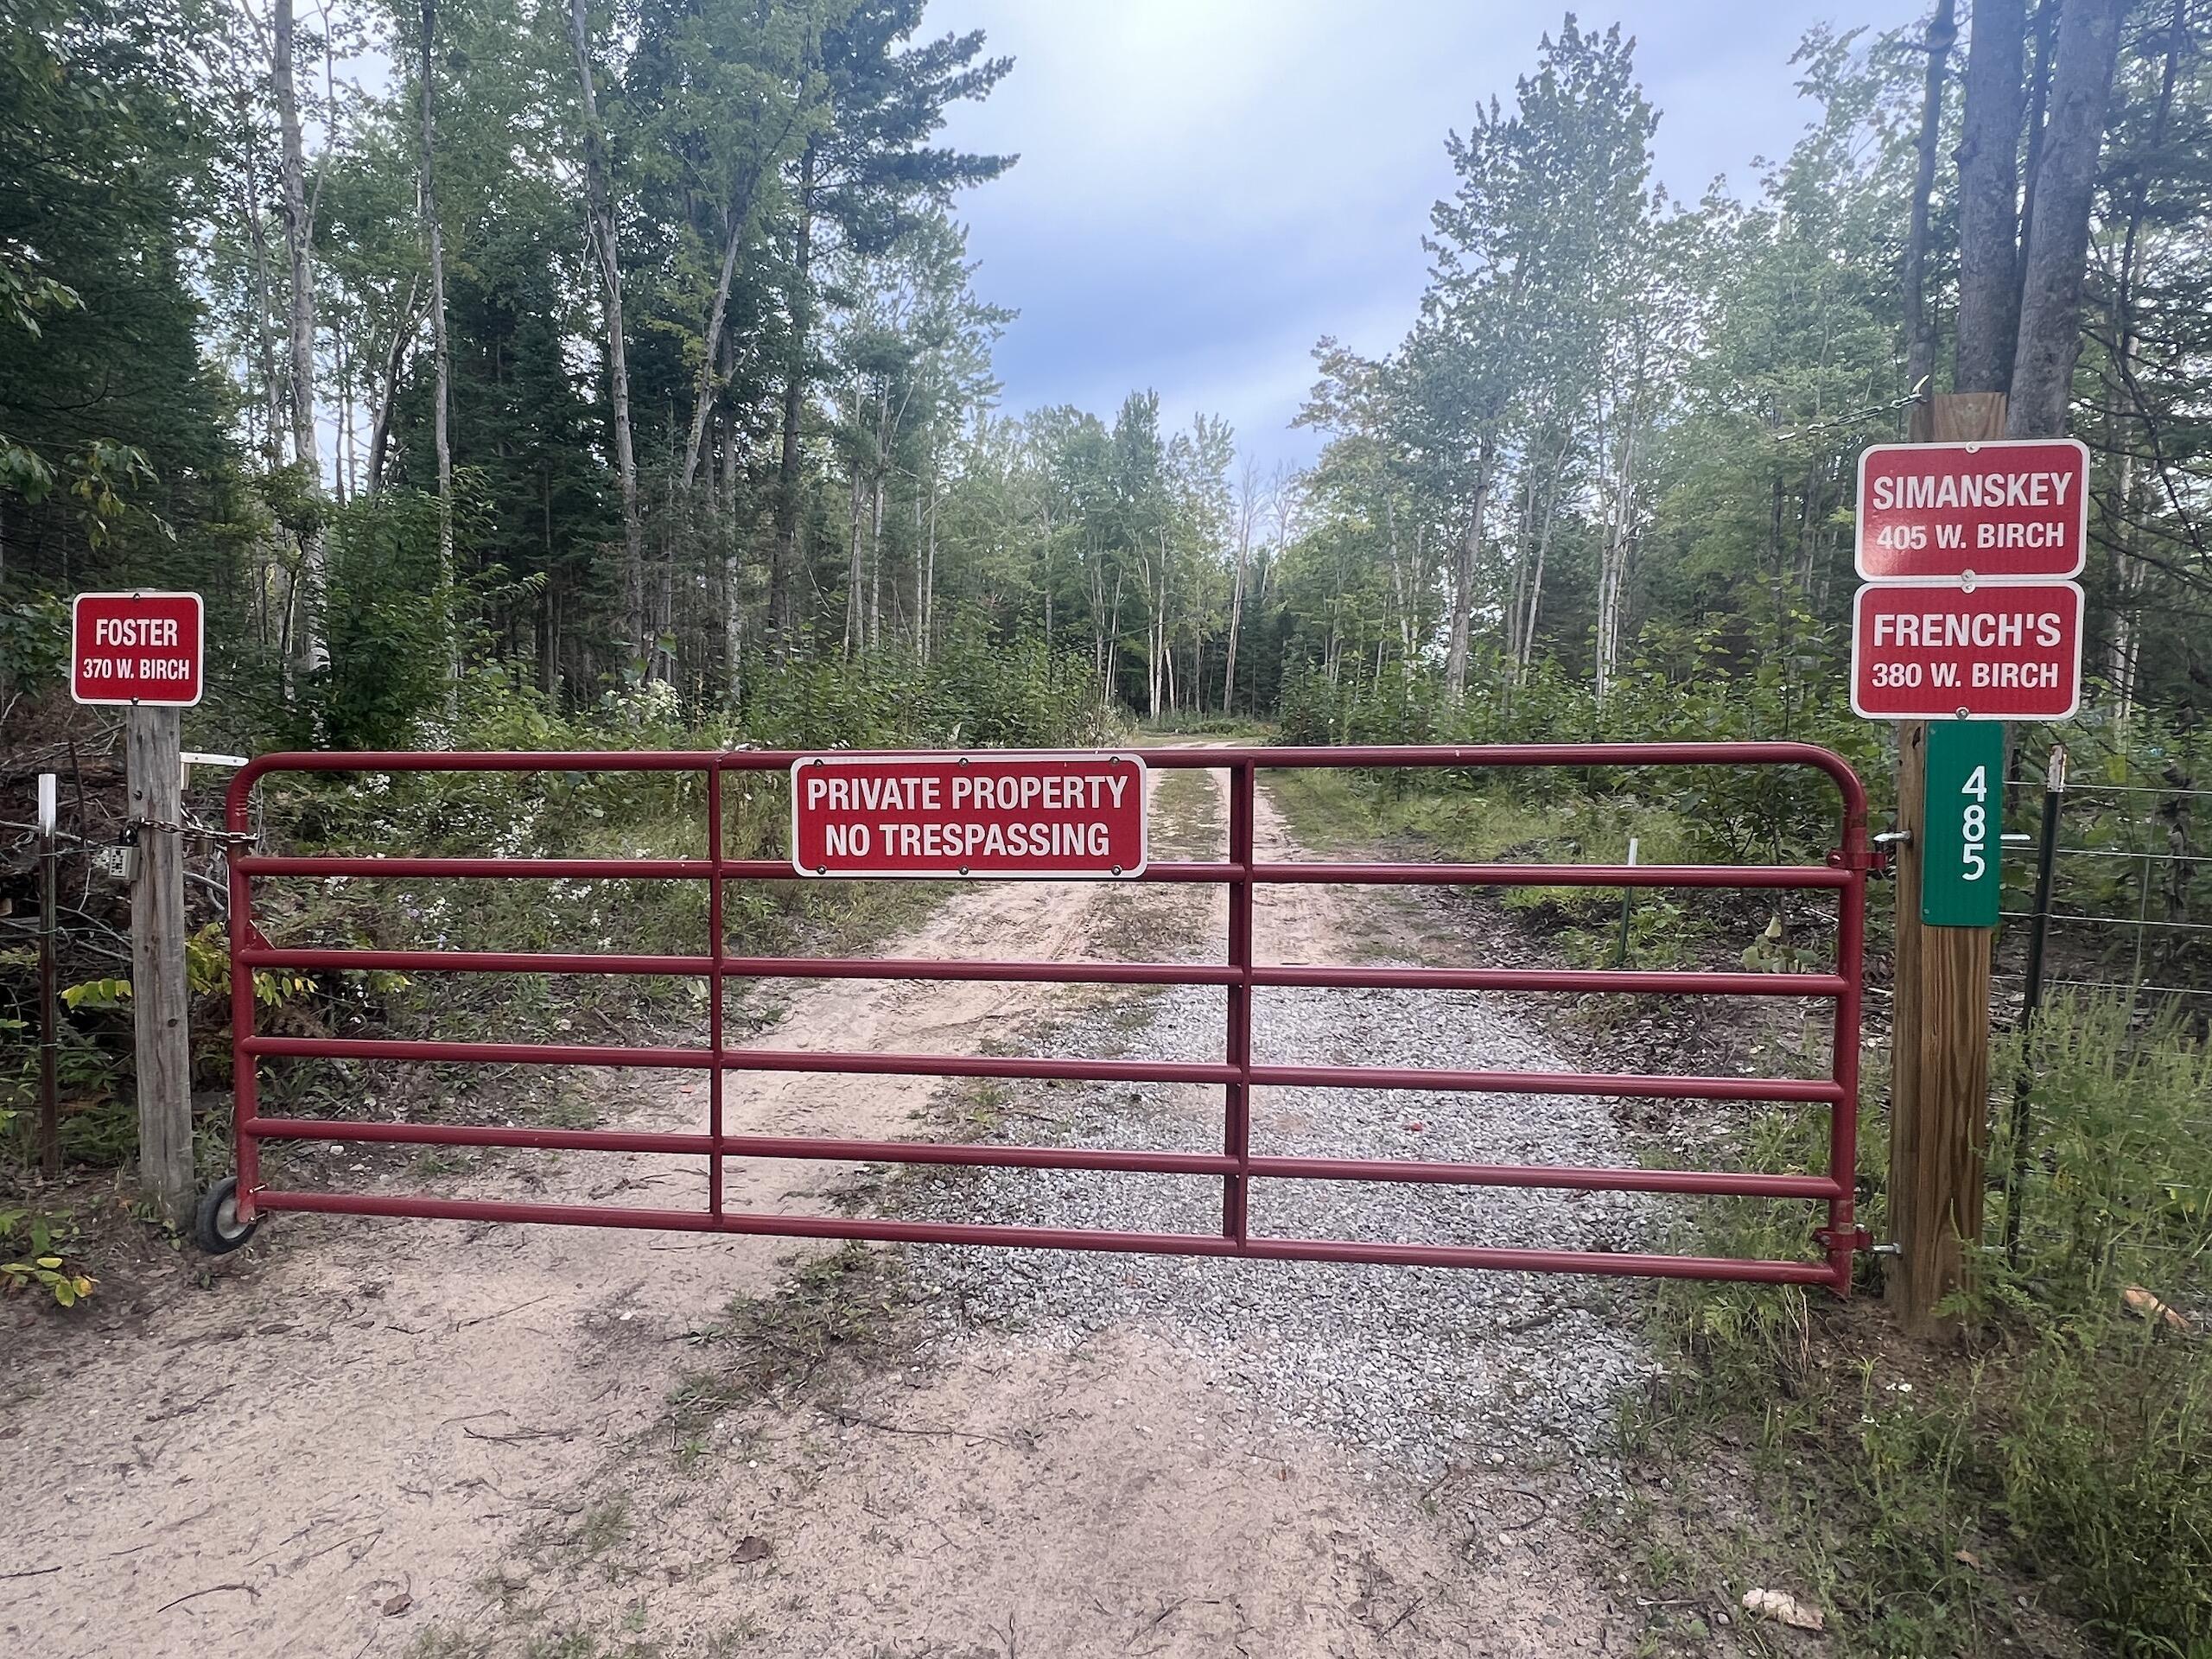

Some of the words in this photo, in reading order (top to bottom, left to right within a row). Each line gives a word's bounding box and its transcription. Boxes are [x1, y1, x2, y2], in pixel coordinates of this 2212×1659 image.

[1872, 473, 2073, 511] SIMANSKEY
[1876, 524, 1928, 550] 405
[1935, 524, 1967, 550] W.
[1977, 523, 2064, 549] BIRCH
[95, 619, 178, 646] FOSTER
[1873, 613, 2062, 647] FRENCH'S
[82, 658, 112, 679] 370
[116, 658, 135, 679] W.
[139, 658, 190, 680] BIRCH
[1872, 663, 1923, 688] 380
[1929, 663, 1961, 688] W.
[1971, 663, 2059, 688] BIRCH
[807, 777, 941, 810] PRIVATE
[951, 775, 1128, 810] PROPERTY
[825, 823, 870, 856] NO
[879, 823, 1109, 856] TRESPASSING
[1961, 766, 1987, 880] 485
